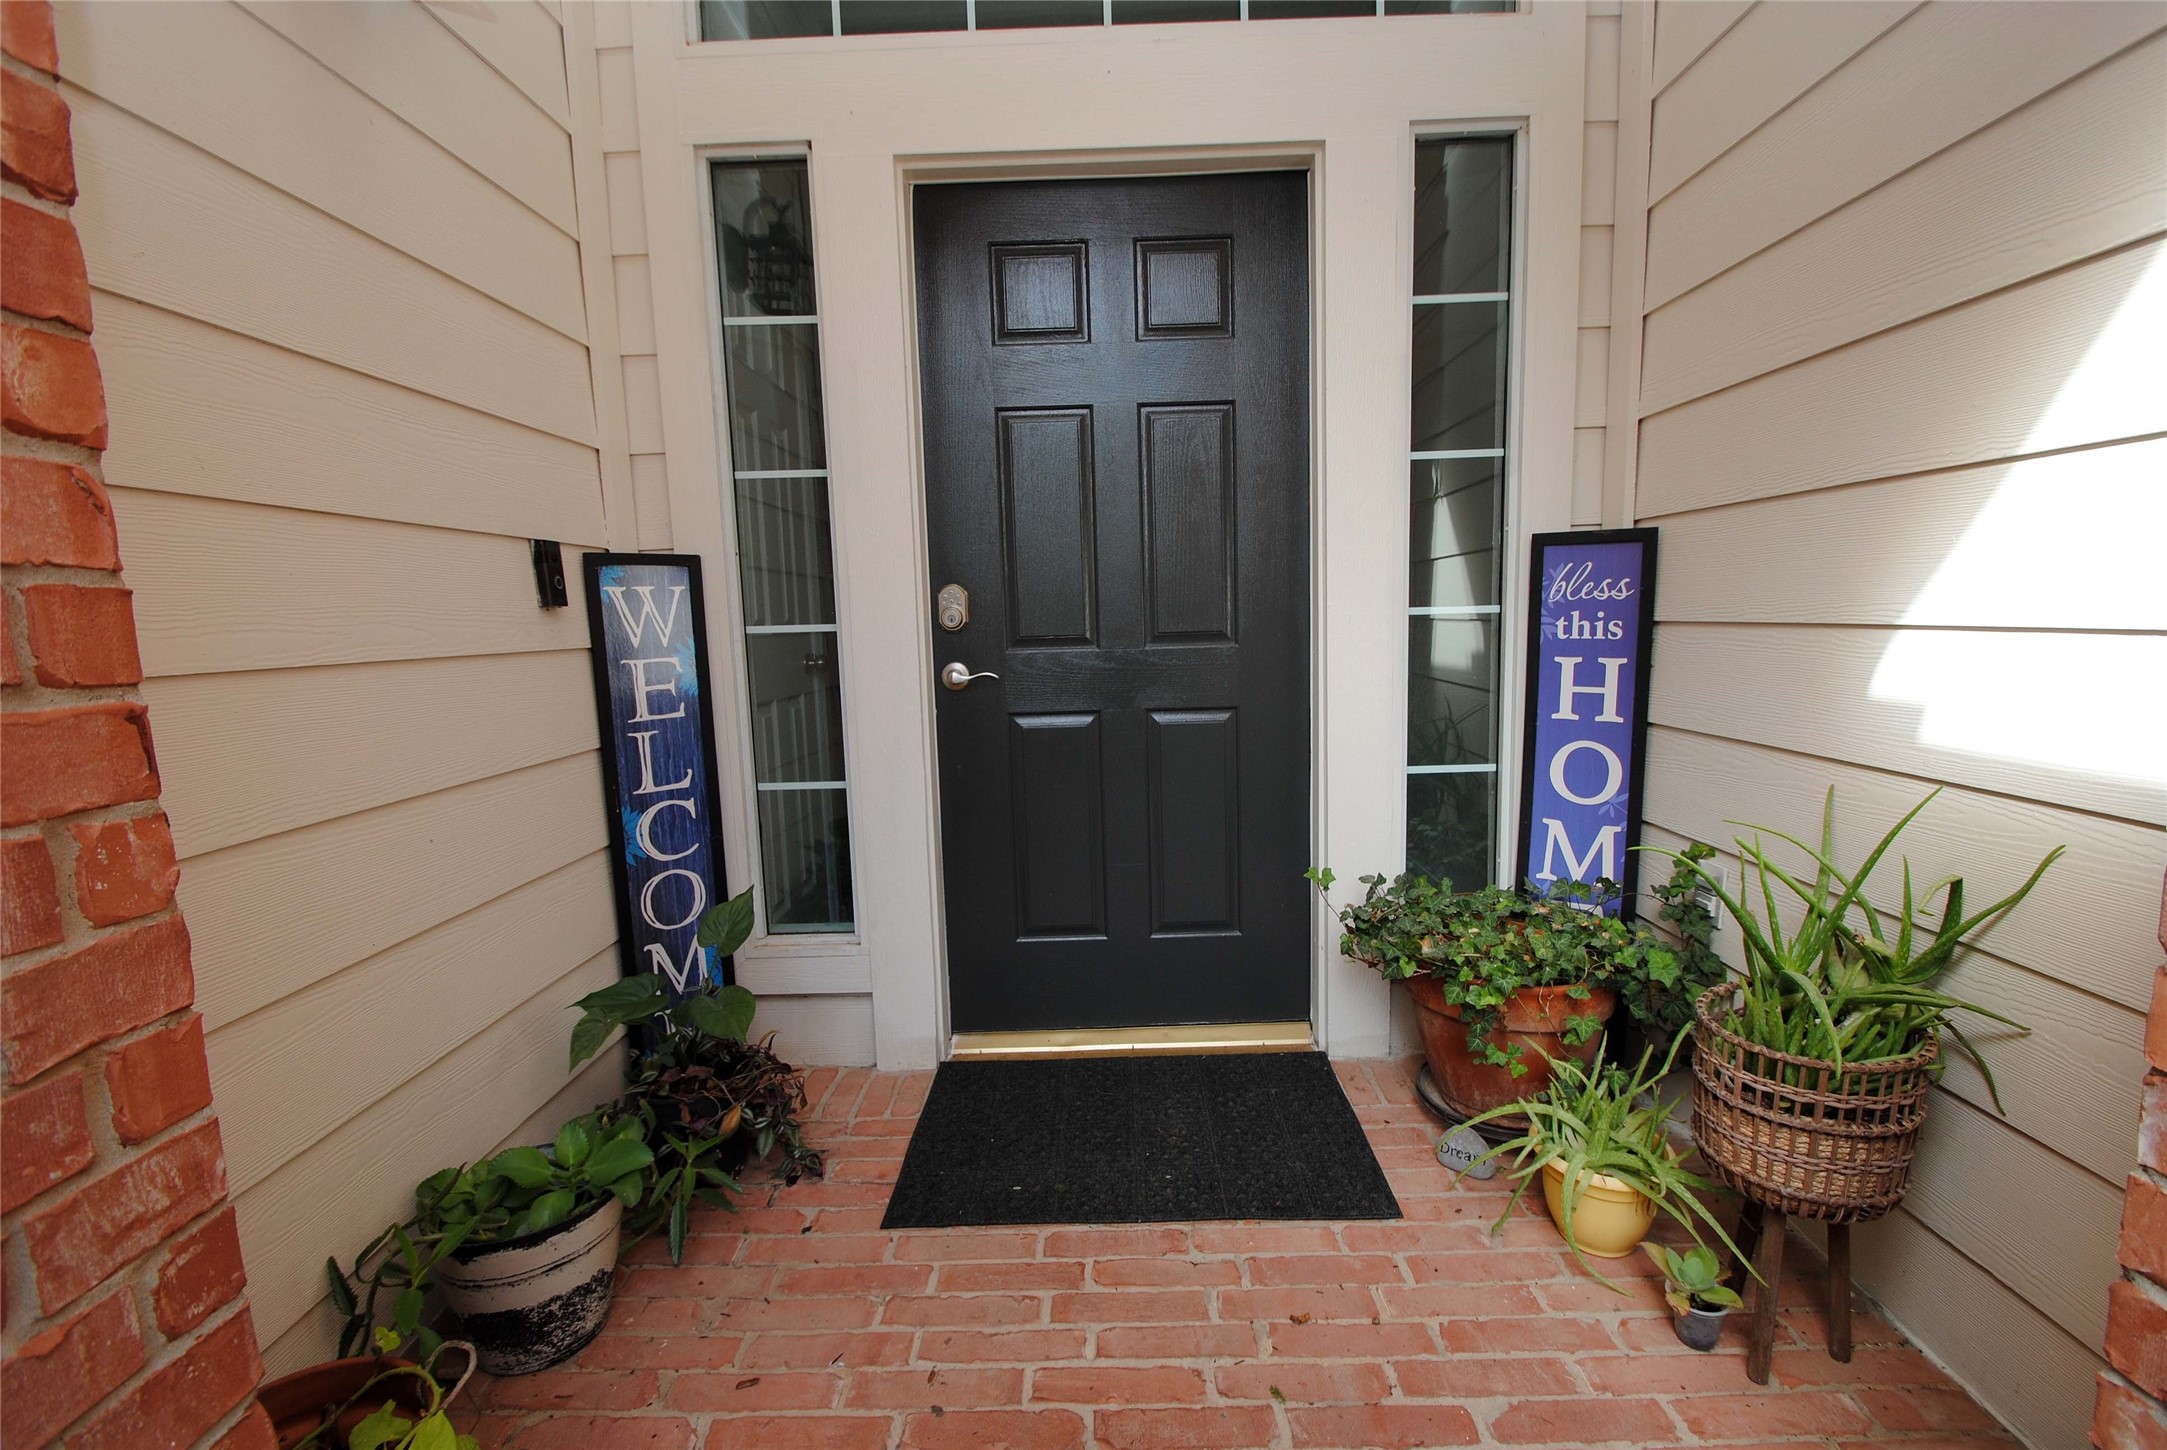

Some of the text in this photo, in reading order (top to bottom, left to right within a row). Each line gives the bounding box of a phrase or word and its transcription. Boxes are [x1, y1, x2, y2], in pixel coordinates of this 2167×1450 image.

[1548, 561, 1635, 603] bless
[1555, 610, 1623, 640] this
[1536, 656, 1628, 918] HOM
